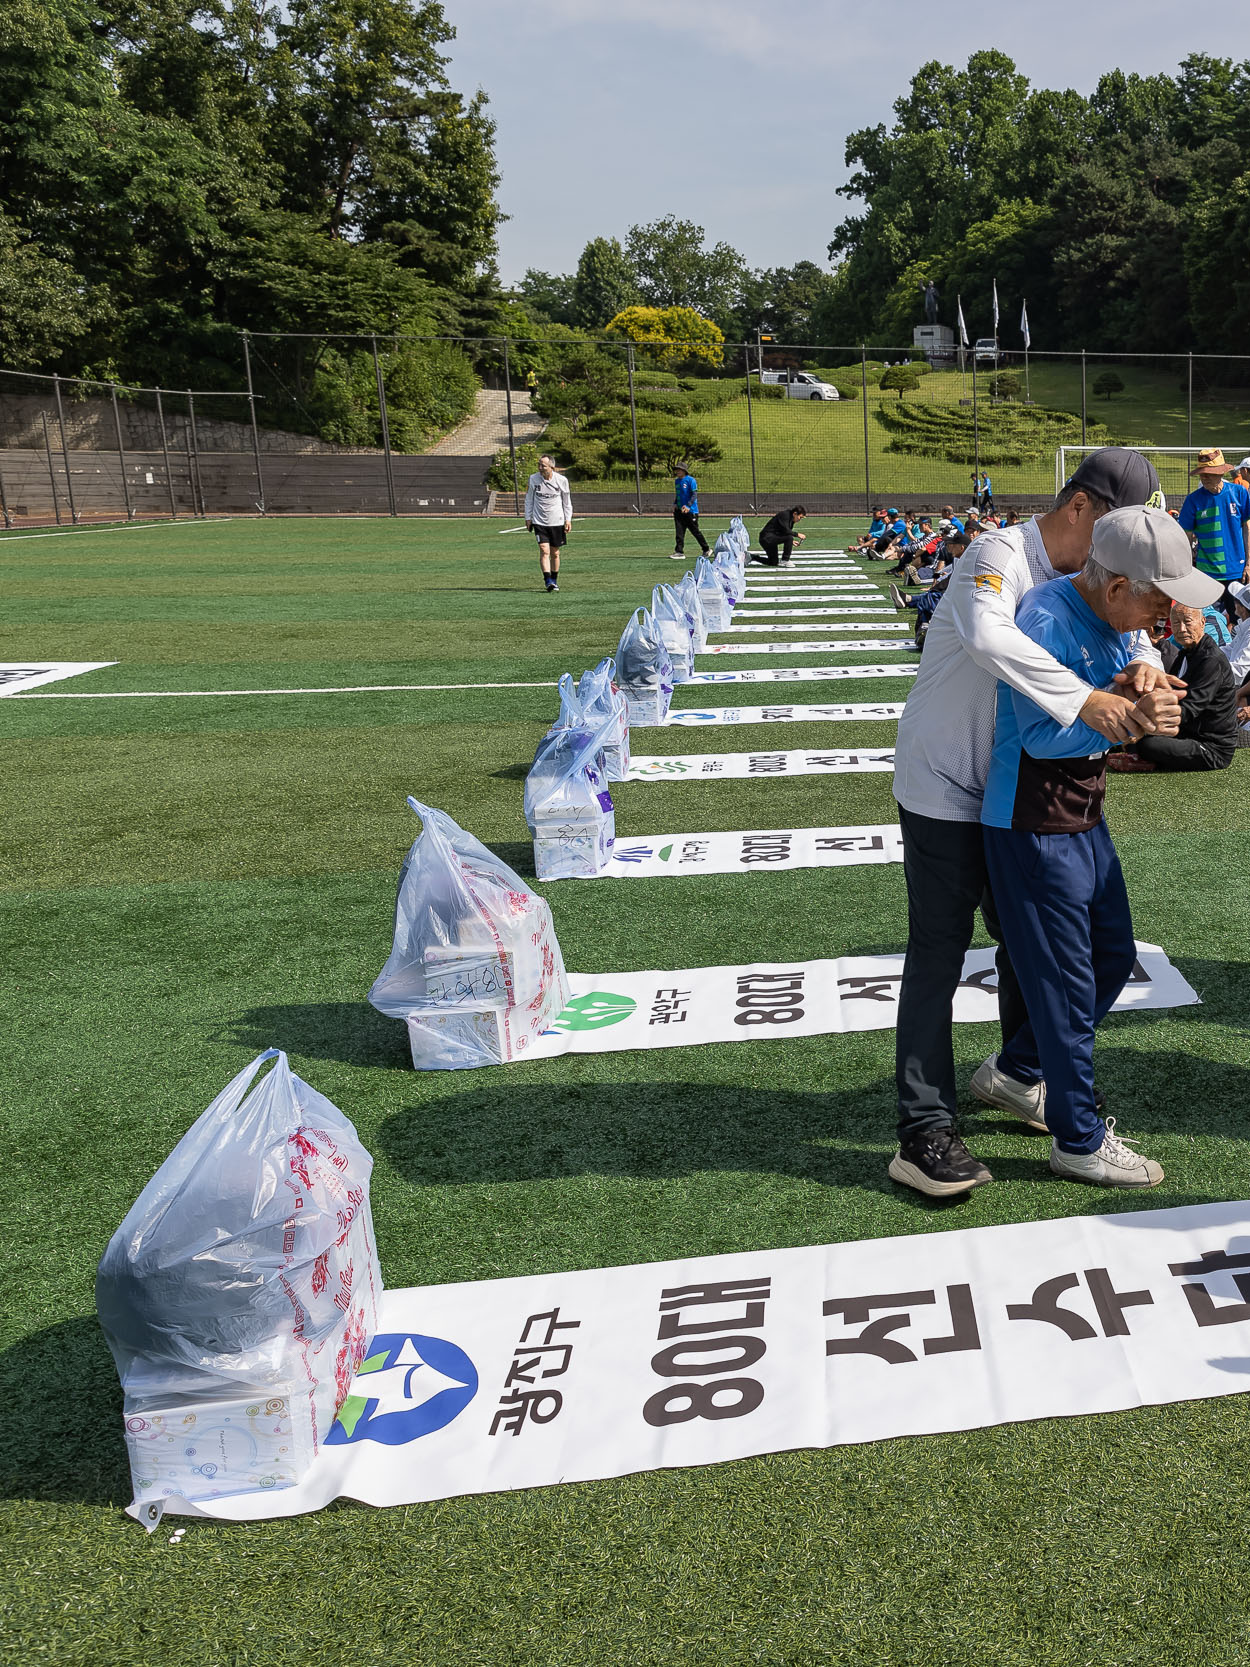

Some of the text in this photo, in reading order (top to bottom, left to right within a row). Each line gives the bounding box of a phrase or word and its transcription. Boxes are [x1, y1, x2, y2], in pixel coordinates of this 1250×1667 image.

[748, 753, 787, 773] 80대
[740, 834, 792, 864] 80대
[649, 988, 692, 1025] 관악구
[734, 971, 805, 1026] 80대
[487, 1307, 582, 1437] 광진구
[642, 1276, 772, 1428] 80대
